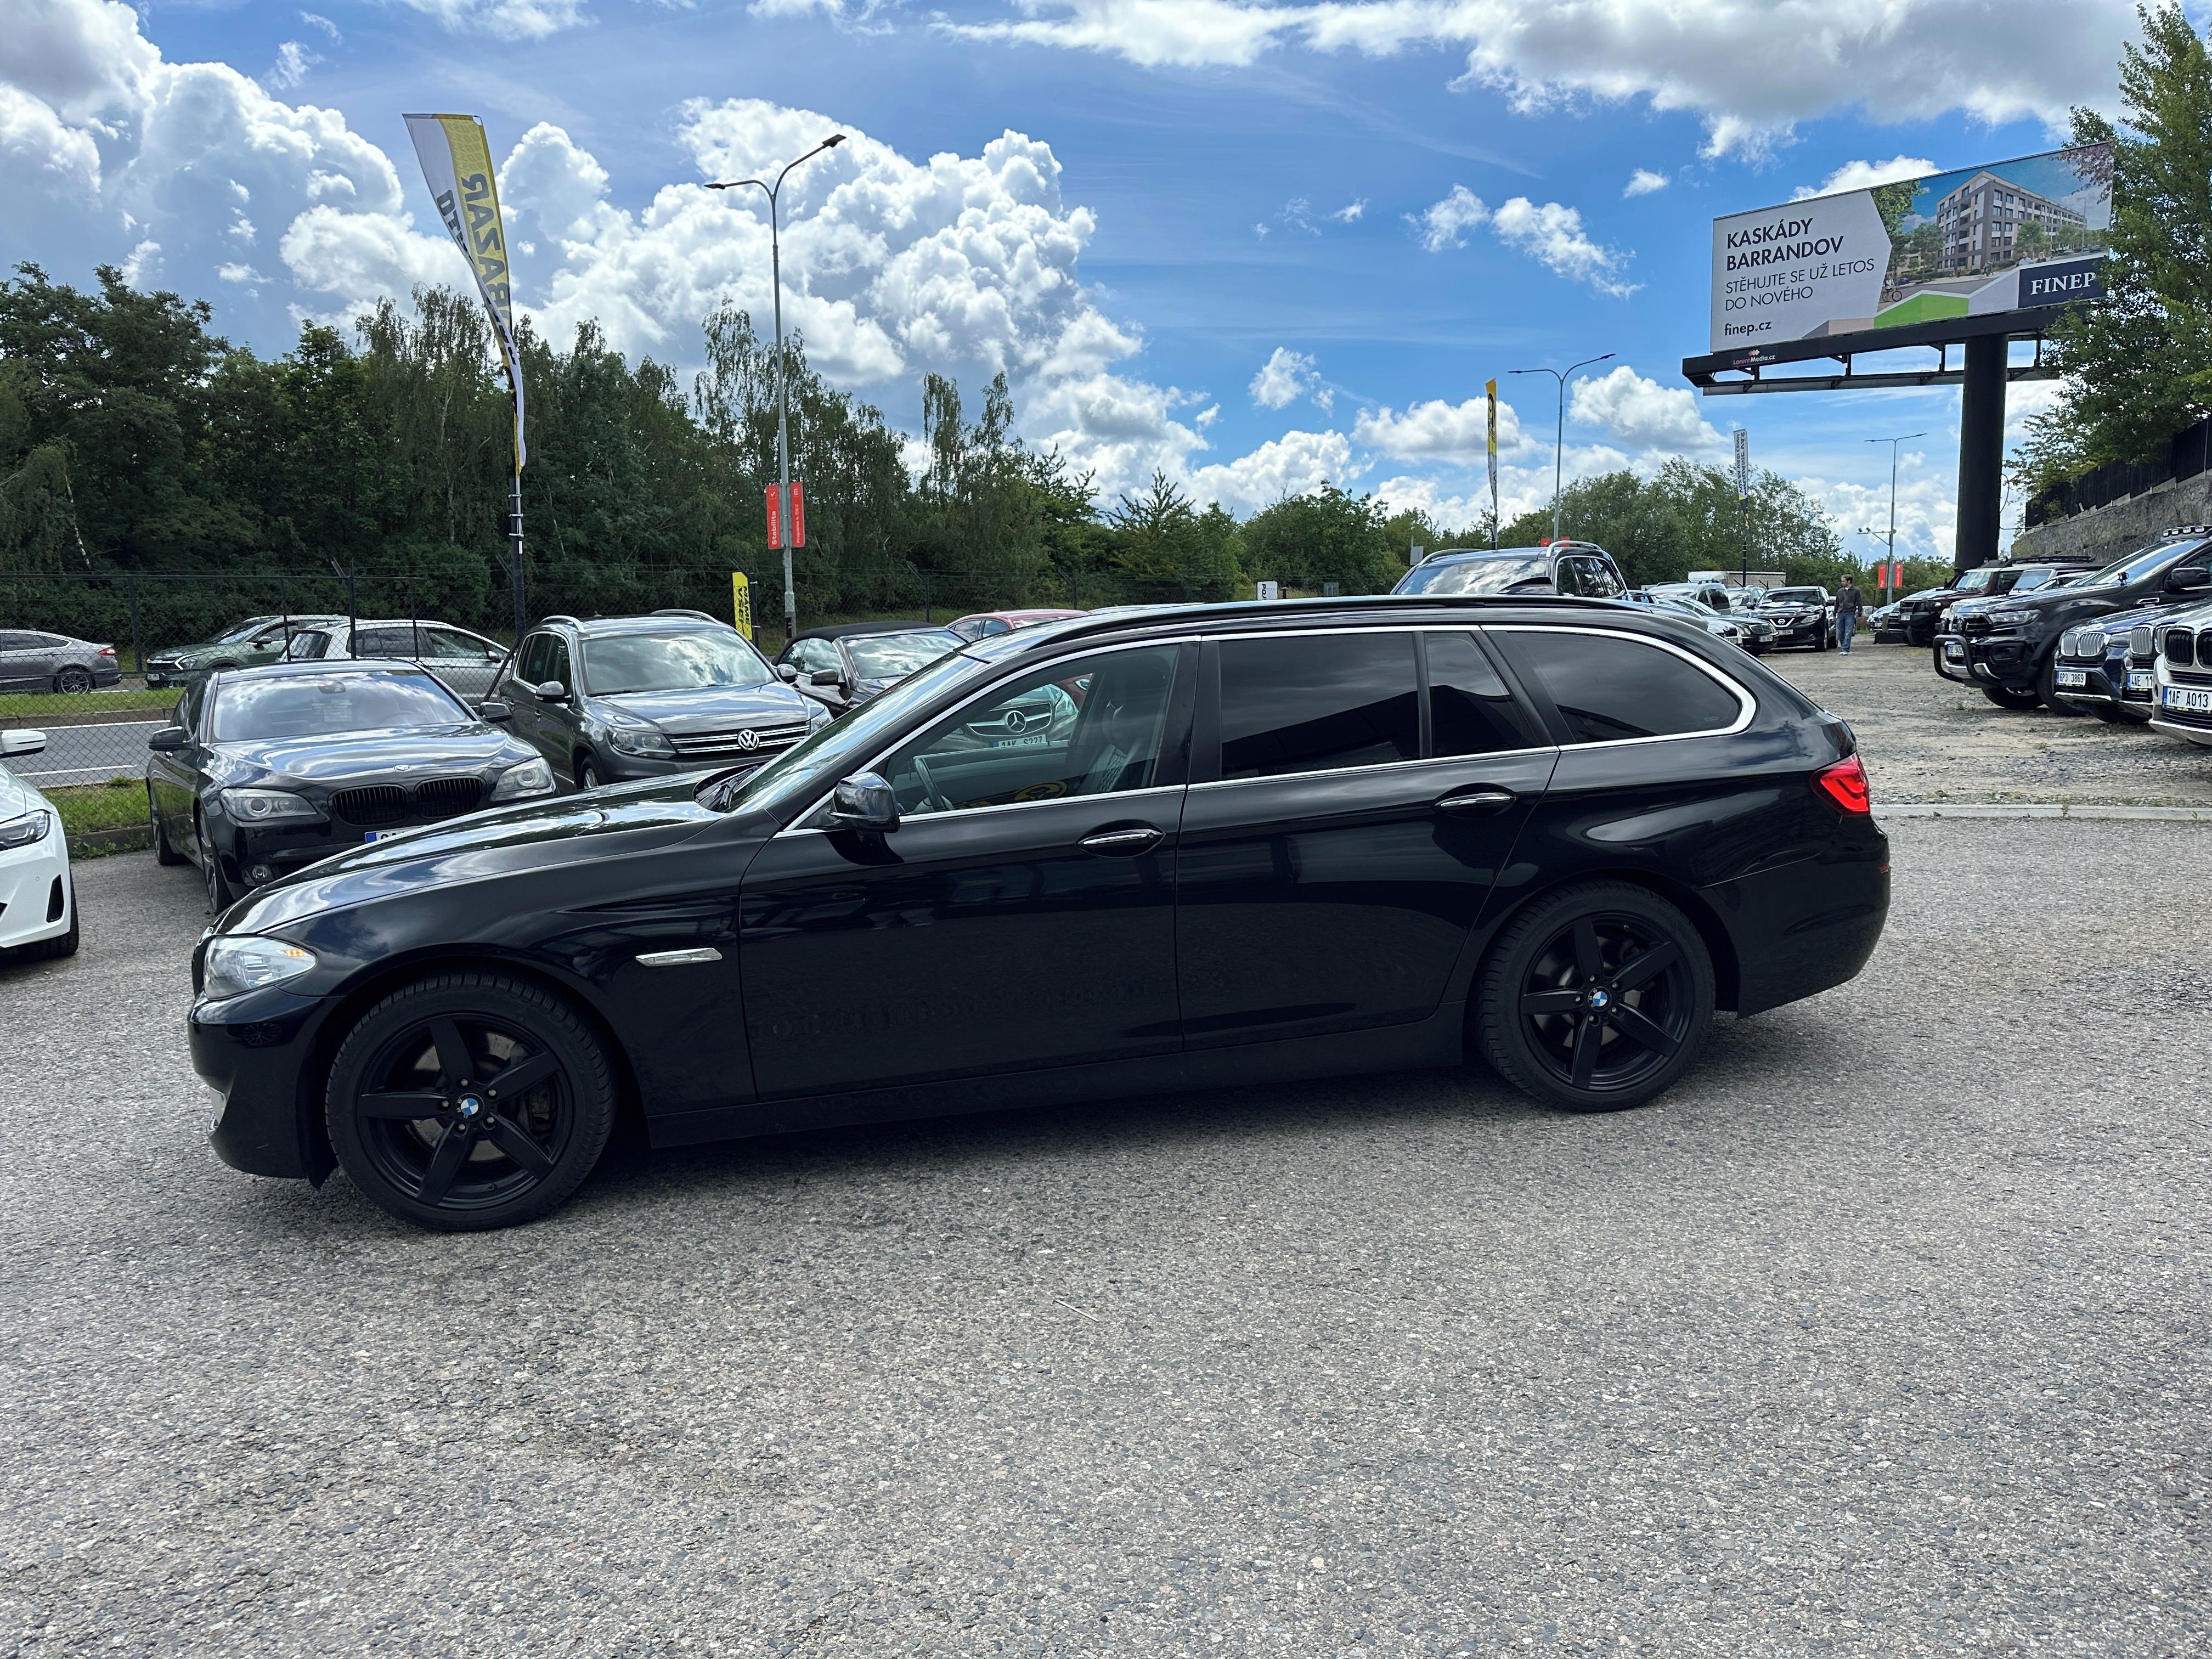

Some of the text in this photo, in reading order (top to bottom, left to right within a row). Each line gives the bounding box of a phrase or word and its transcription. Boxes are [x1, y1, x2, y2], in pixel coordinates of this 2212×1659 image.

[1727, 218, 1813, 249] KASKÁDY
[1726, 236, 1844, 271] BARRANDOV
[1725, 258, 1875, 294] STĚHUJTE SE UŽ LETOS
[2030, 272, 2096, 295] FINEP
[1725, 286, 1813, 311] DO NOVÉHO
[1724, 321, 1772, 336] finep.cz
[2169, 690, 2208, 708] 1AF A013
